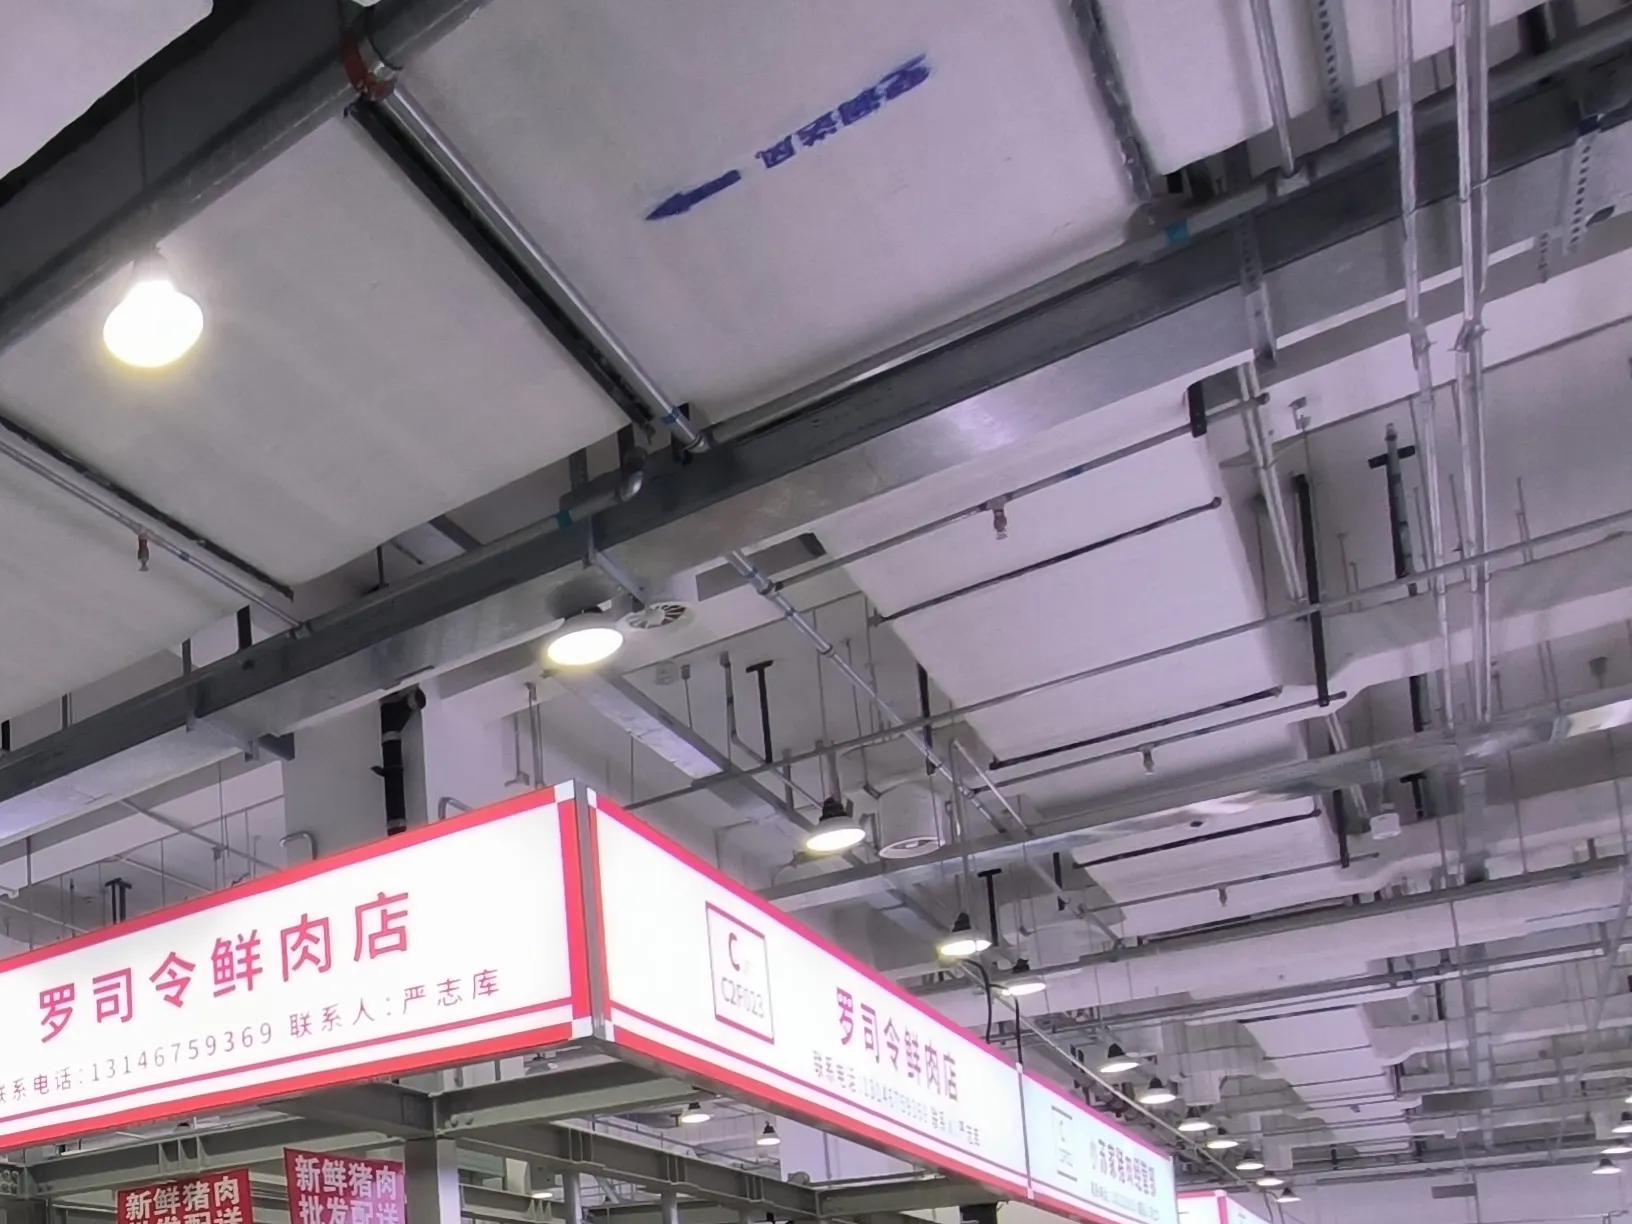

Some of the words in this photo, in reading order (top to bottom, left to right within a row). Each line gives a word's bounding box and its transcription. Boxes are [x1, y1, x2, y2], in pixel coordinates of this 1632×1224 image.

[39, 892, 408, 1043] 罗司令鲜肉店
[837, 986, 958, 1101] 罗司令鲜肉店
[126, 1176, 240, 1220] 新鲜猪肉
[295, 1155, 397, 1200] 新鲜猪肉
